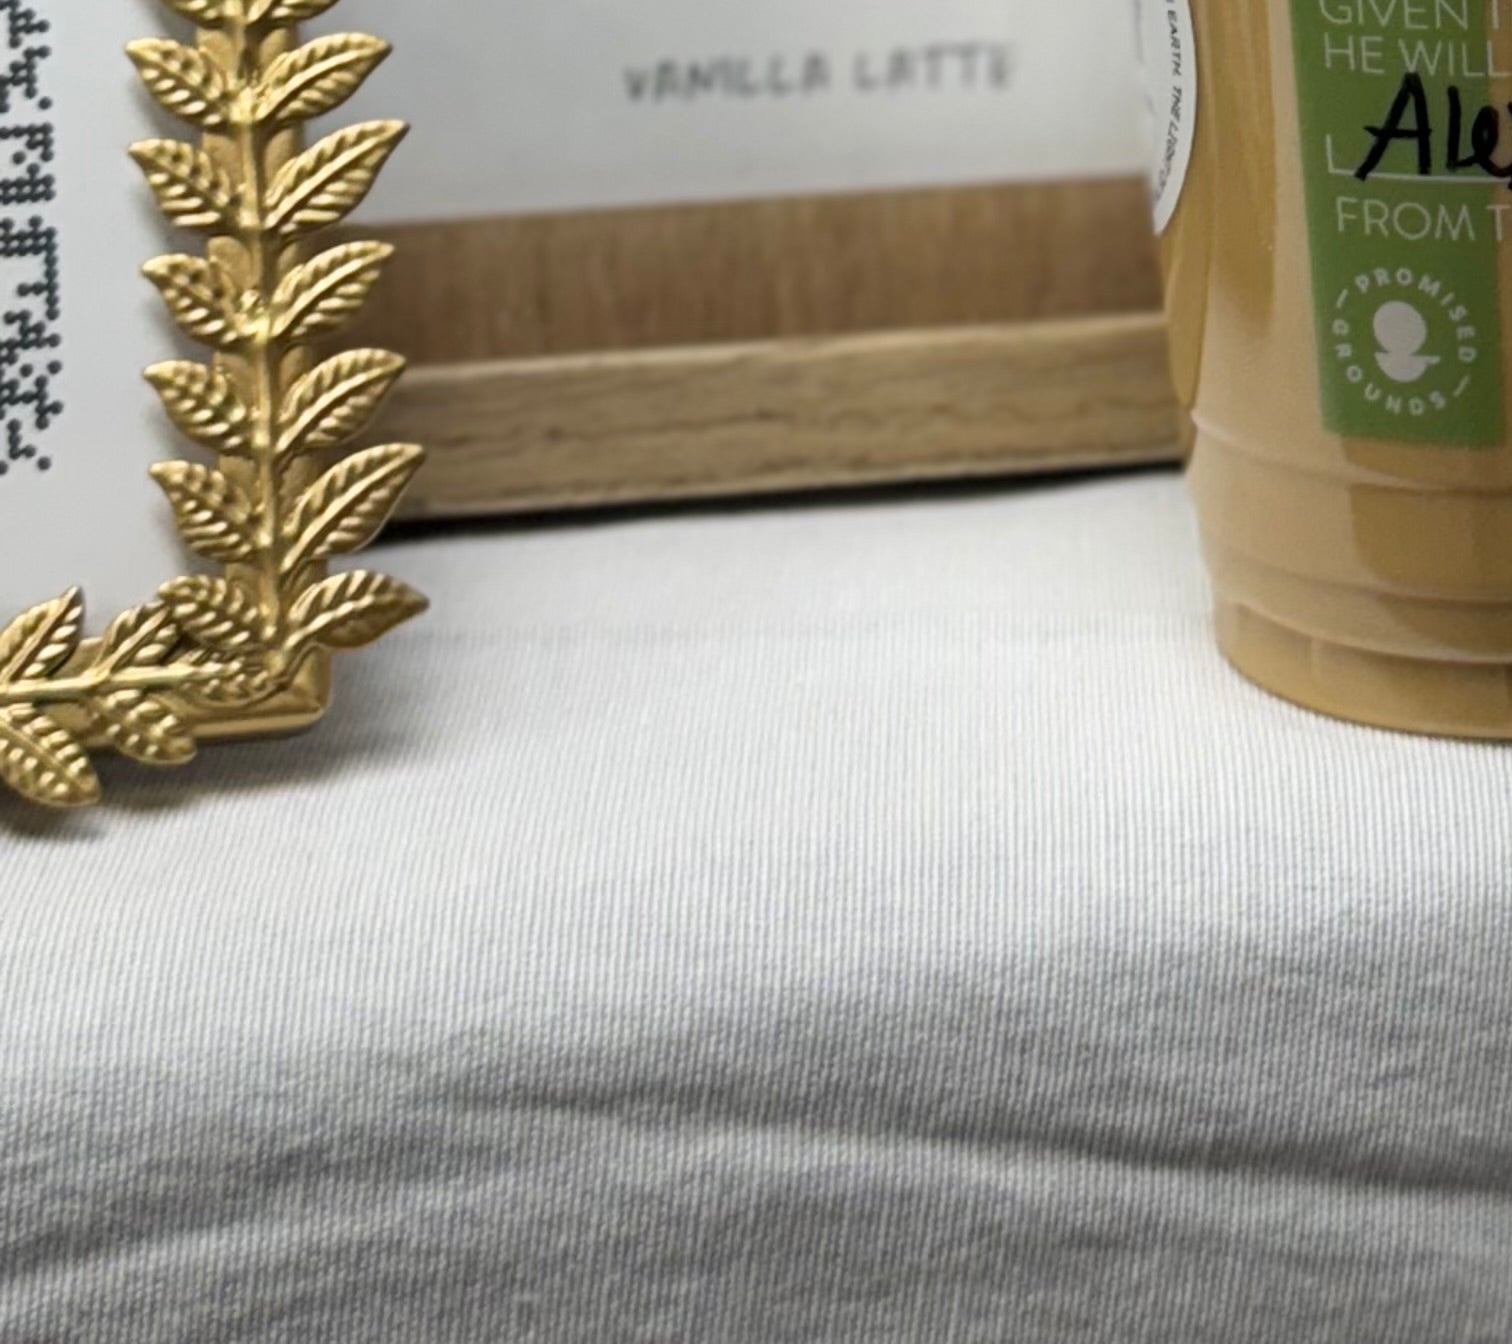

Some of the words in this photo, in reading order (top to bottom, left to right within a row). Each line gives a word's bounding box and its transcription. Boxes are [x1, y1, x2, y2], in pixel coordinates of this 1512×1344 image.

[621, 50, 833, 107] VANILLA
[852, 40, 1020, 95] LATTE
[1324, 31, 1386, 75] HE
[1399, 38, 1512, 78] WILL
[1335, 195, 1476, 242] FROM
[1354, 266, 1478, 363] PROMISED
[1331, 317, 1447, 417] GROUNDS
